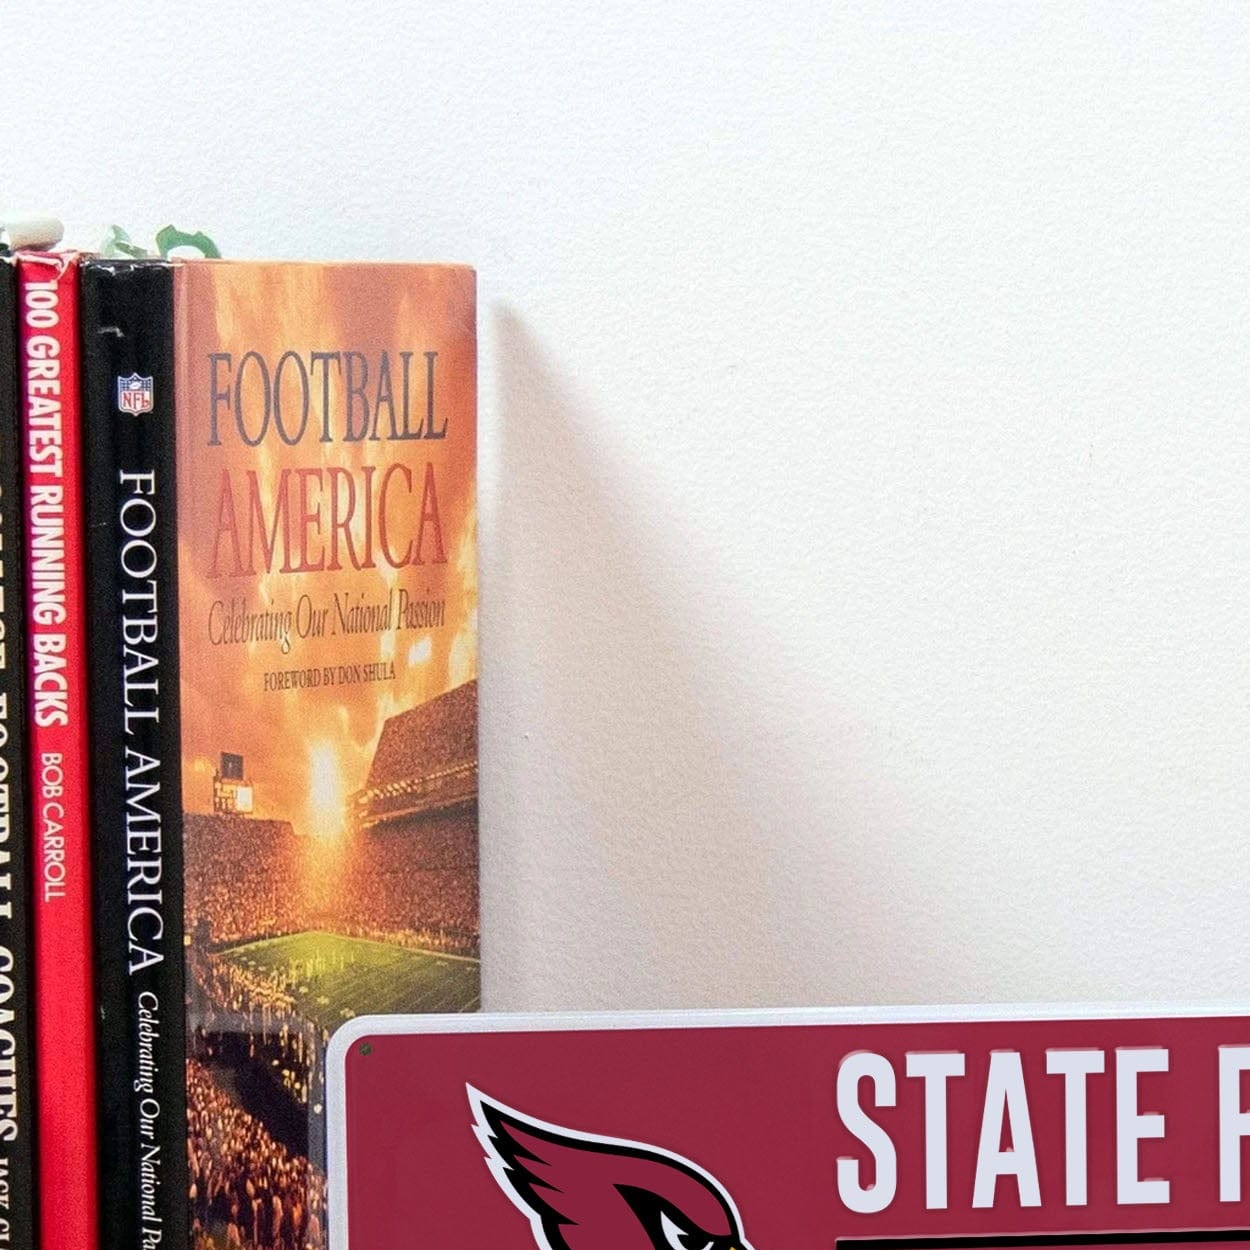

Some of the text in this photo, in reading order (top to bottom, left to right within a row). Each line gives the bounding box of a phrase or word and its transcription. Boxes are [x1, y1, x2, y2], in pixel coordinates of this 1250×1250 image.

[123, 391, 150, 411] NFL
[207, 350, 448, 446] FOOTBALL
[25, 279, 68, 728] 100 GREATEST RUNNING BACKS
[206, 462, 448, 578] AMERICA
[207, 588, 446, 655] Celebrating Our National Passion
[119, 469, 165, 975] FOOTBALL AMERICA
[263, 660, 396, 692] FOREWORD BY DON SHULA
[40, 752, 66, 903] BOB CARROLL
[134, 992, 160, 1093] Celebrating
[139, 1098, 161, 1138] Our
[836, 1048, 1170, 1214] STATE
[139, 1139, 162, 1222] National
